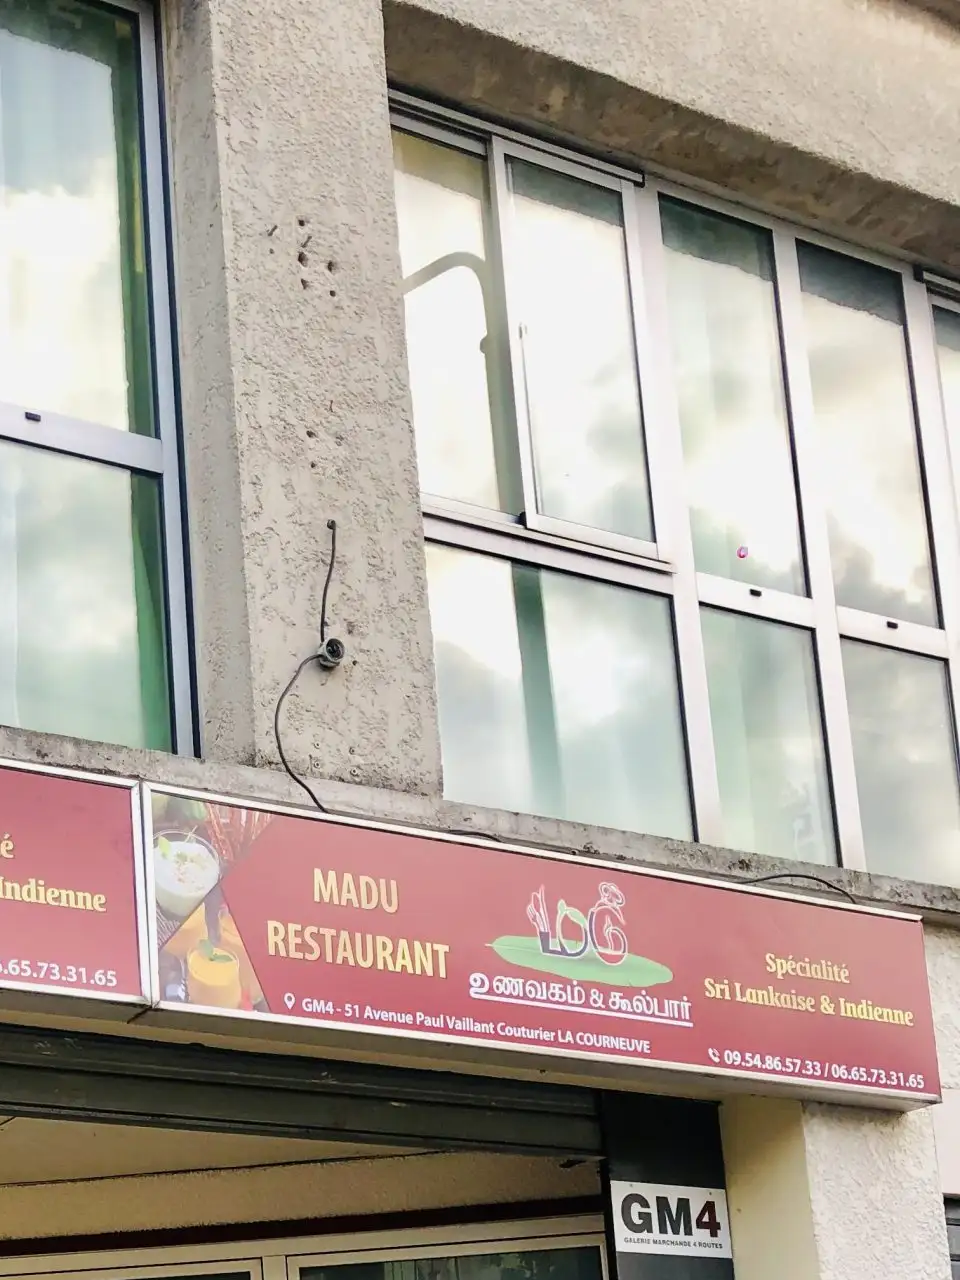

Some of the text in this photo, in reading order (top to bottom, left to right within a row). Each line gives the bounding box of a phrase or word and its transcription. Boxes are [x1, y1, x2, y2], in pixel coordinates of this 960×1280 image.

[313, 868, 399, 914] MADU
[267, 920, 450, 979] RESTAURANT
[765, 953, 850, 984] Spécialité
[469, 972, 692, 1020] உணவகம் & கூல்பார்
[704, 978, 914, 1026] Sri Lankaise & Indienne
[302, 997, 334, 1016] GM4
[344, 1003, 360, 1020] 51
[364, 1005, 413, 1026] Avenue
[416, 1012, 444, 1029] Paul
[446, 1014, 495, 1035] Vaillant
[497, 1022, 555, 1042] Couturier
[557, 1029, 574, 1044] LA
[576, 1032, 651, 1054] COURNEUVE
[724, 1050, 821, 1077] 09.54.86.57.33
[831, 1064, 925, 1089] 06.65.73.31.65
[621, 1193, 721, 1238] GM4
[624, 1237, 651, 1245] GALERIE
[652, 1239, 691, 1248] MARCHANDE
[698, 1241, 723, 1249] ROUTES
